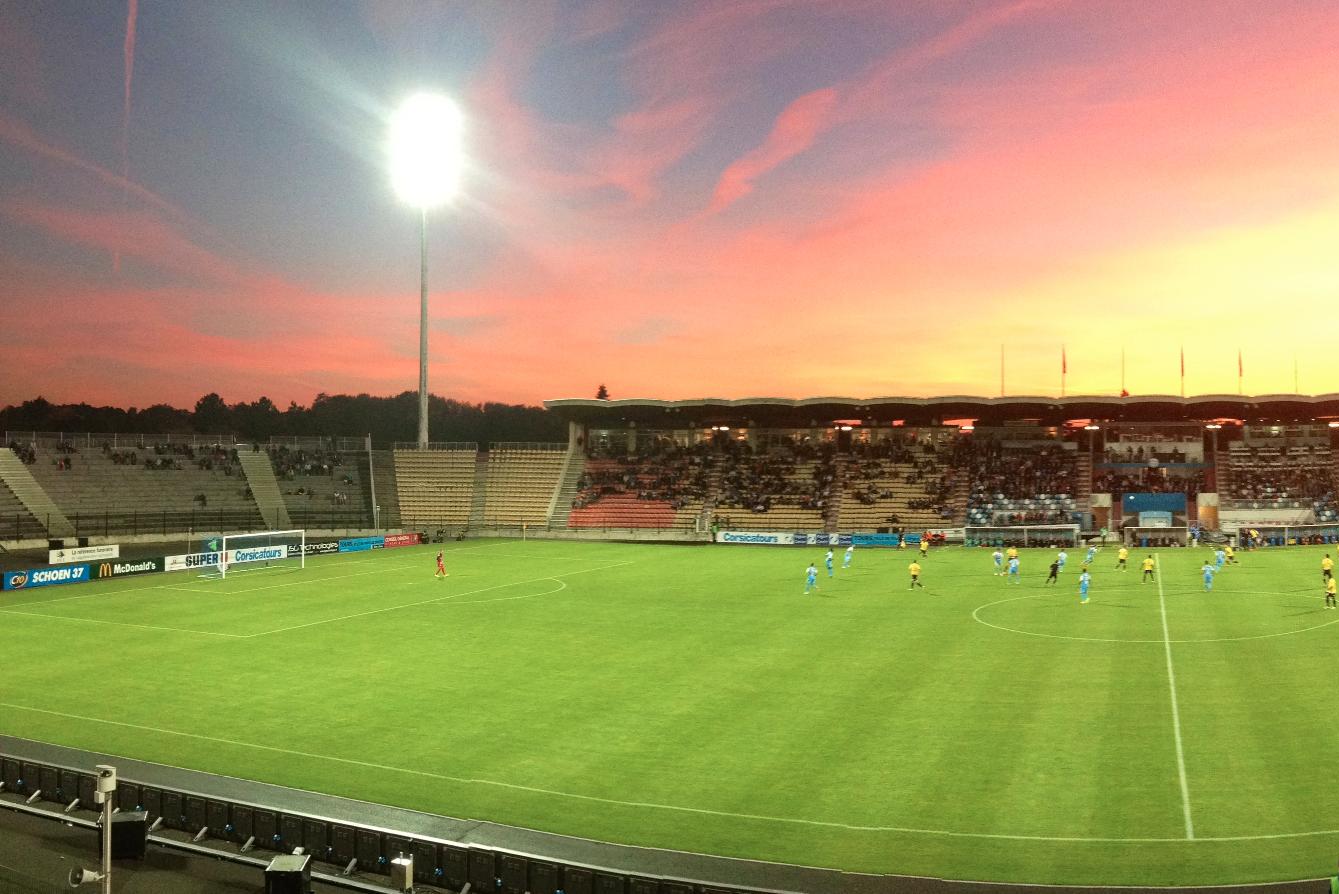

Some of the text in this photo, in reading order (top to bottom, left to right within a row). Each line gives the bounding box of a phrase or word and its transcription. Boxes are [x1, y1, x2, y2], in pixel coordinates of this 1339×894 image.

[723, 532, 779, 543] Corsicatours
[185, 553, 219, 567] SUPER
[235, 548, 282, 561] Corsicatours
[114, 561, 156, 574] McDonald's
[32, 568, 84, 583] SCHOEN 37
